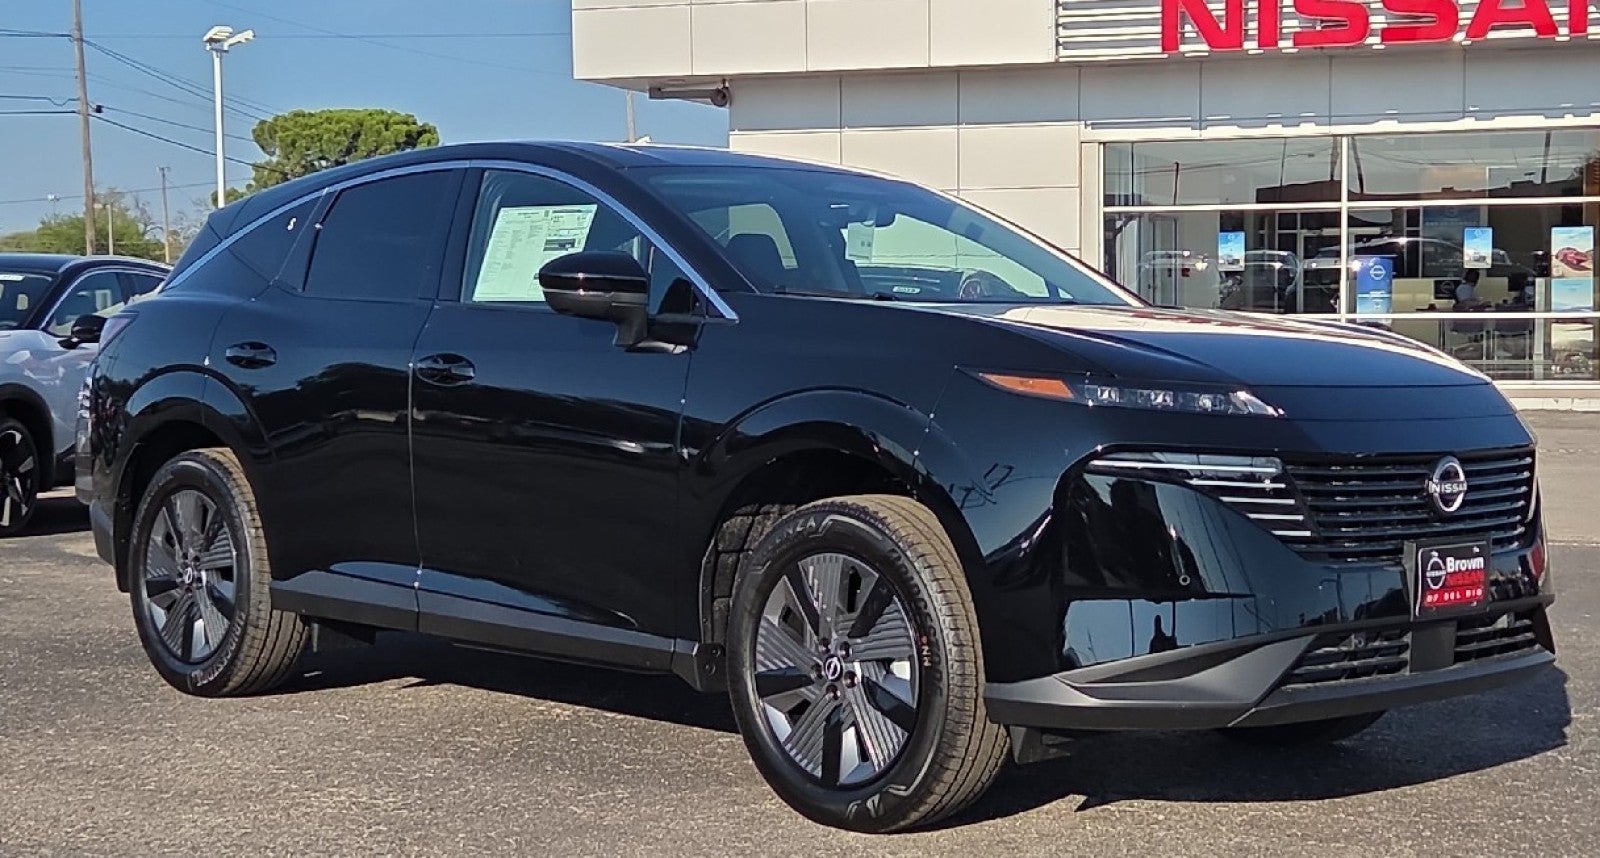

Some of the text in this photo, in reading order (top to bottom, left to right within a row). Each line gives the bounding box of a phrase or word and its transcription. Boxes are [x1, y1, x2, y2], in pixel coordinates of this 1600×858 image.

[1162, 0, 1588, 53] NISSA
[1428, 480, 1467, 493] NISSAN
[1446, 557, 1484, 572] Brown
